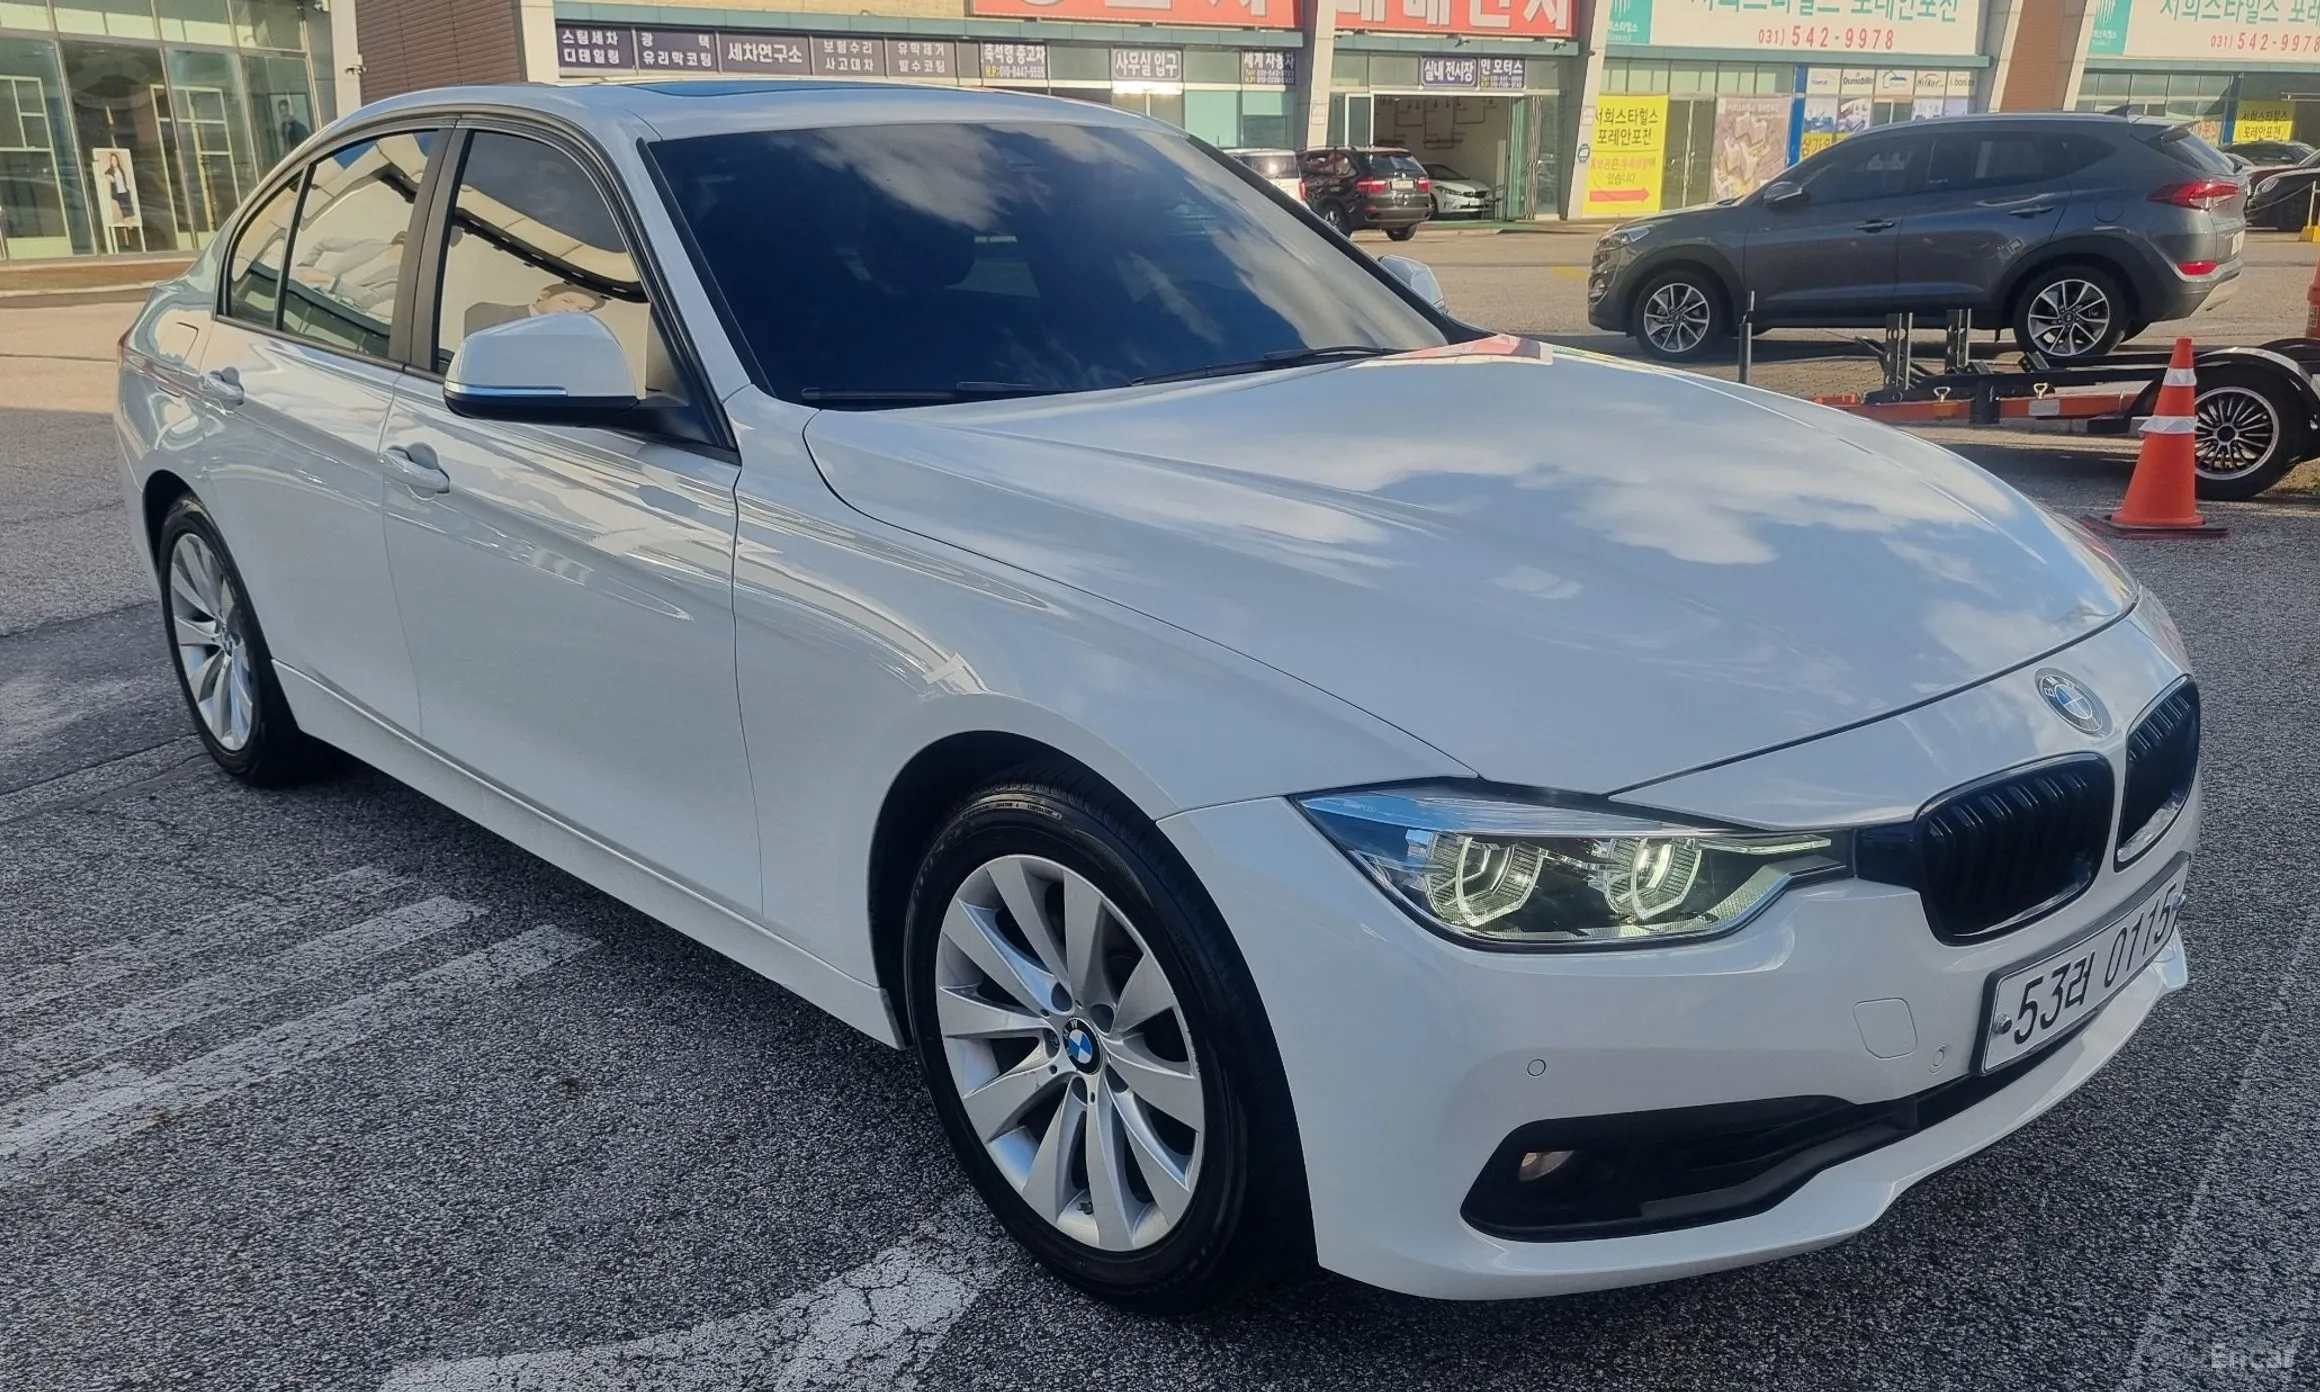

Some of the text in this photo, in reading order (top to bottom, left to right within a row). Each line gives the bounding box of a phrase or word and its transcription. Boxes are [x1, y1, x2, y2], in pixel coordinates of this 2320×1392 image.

[562, 29, 618, 46] 스팀세차
[1758, 25, 1894, 50] 031) 542-9978
[2210, 34, 2234, 49] 031)
[564, 48, 620, 65] 디테일링
[643, 51, 712, 67] 유리막코팅
[728, 42, 803, 64] 세차연구소
[1016, 45, 1046, 65] 중고차
[1116, 52, 1178, 78] 사무실 입구
[1424, 60, 1474, 82] 실내 전시장
[1596, 128, 1652, 146] 포레안포천
[2104, 880, 2177, 988] 0115
